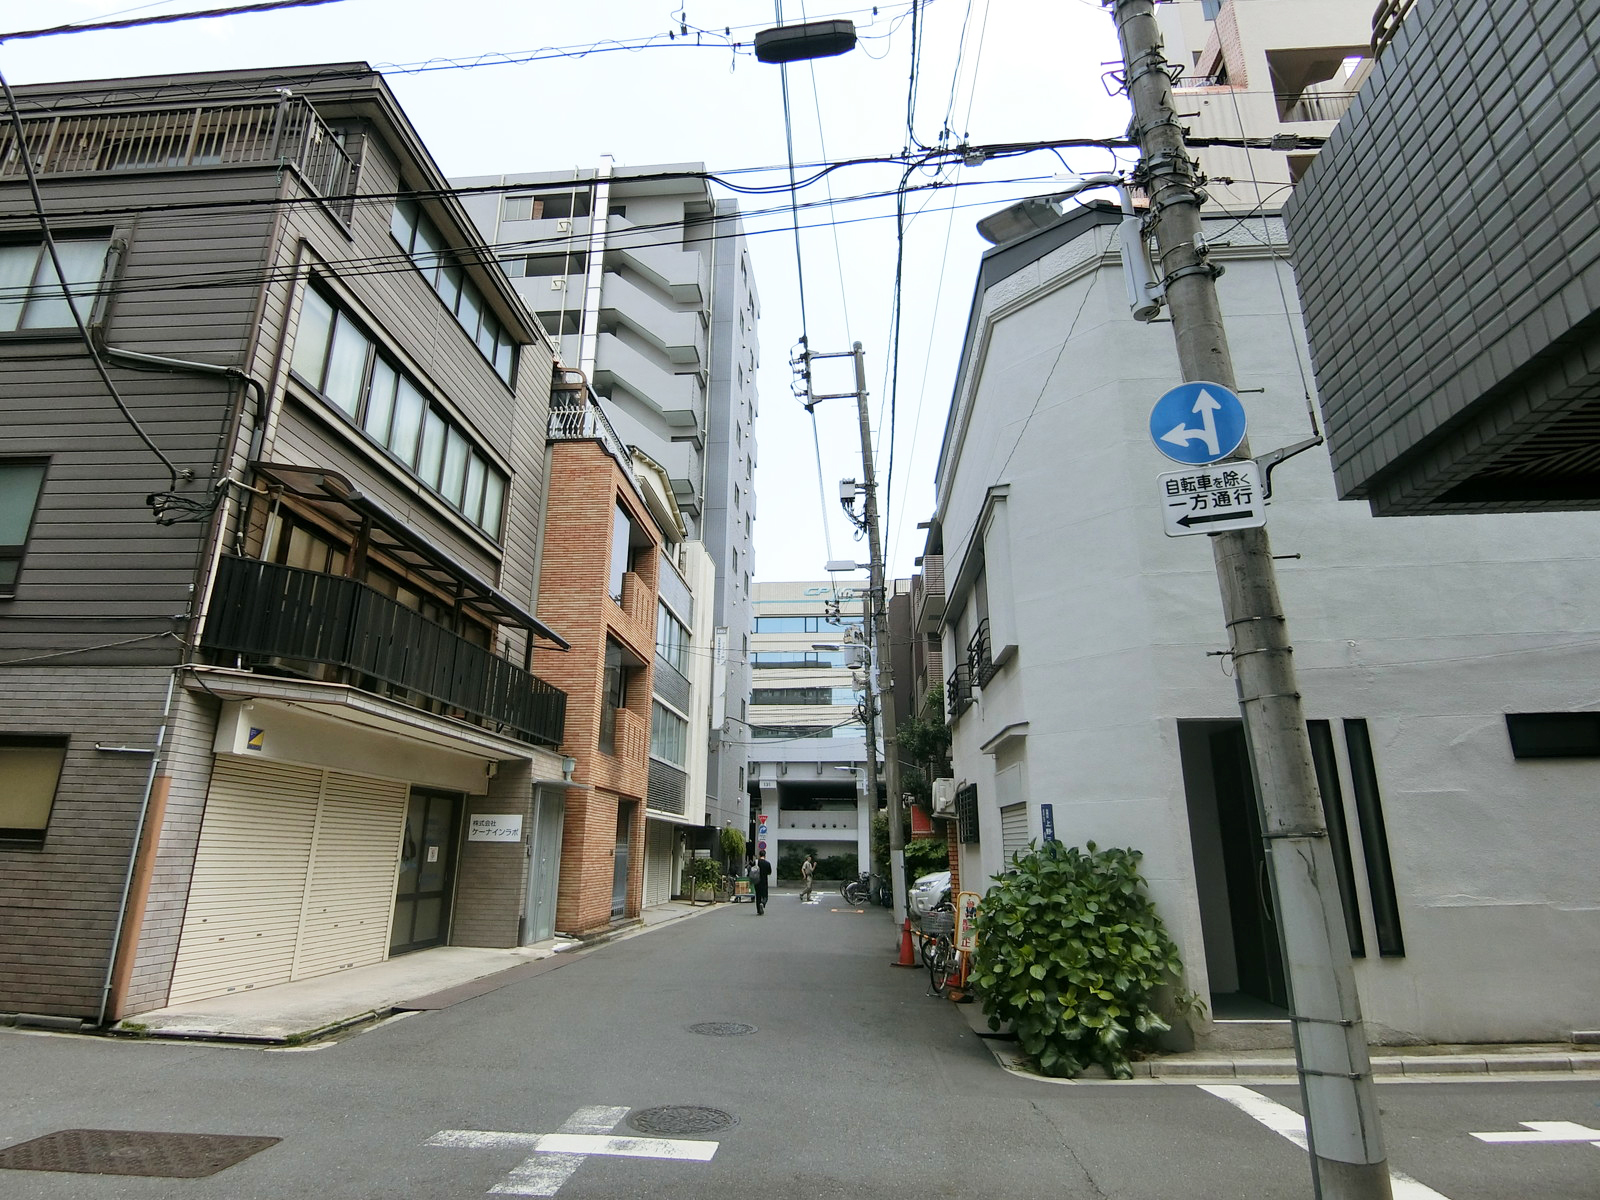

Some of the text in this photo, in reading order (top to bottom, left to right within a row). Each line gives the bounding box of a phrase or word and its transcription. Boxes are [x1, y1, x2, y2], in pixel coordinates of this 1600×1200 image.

[1165, 470, 1250, 495] 自転車を除く
[1169, 487, 1252, 510] 一方通行
[472, 828, 519, 836] ケーナインラボ
